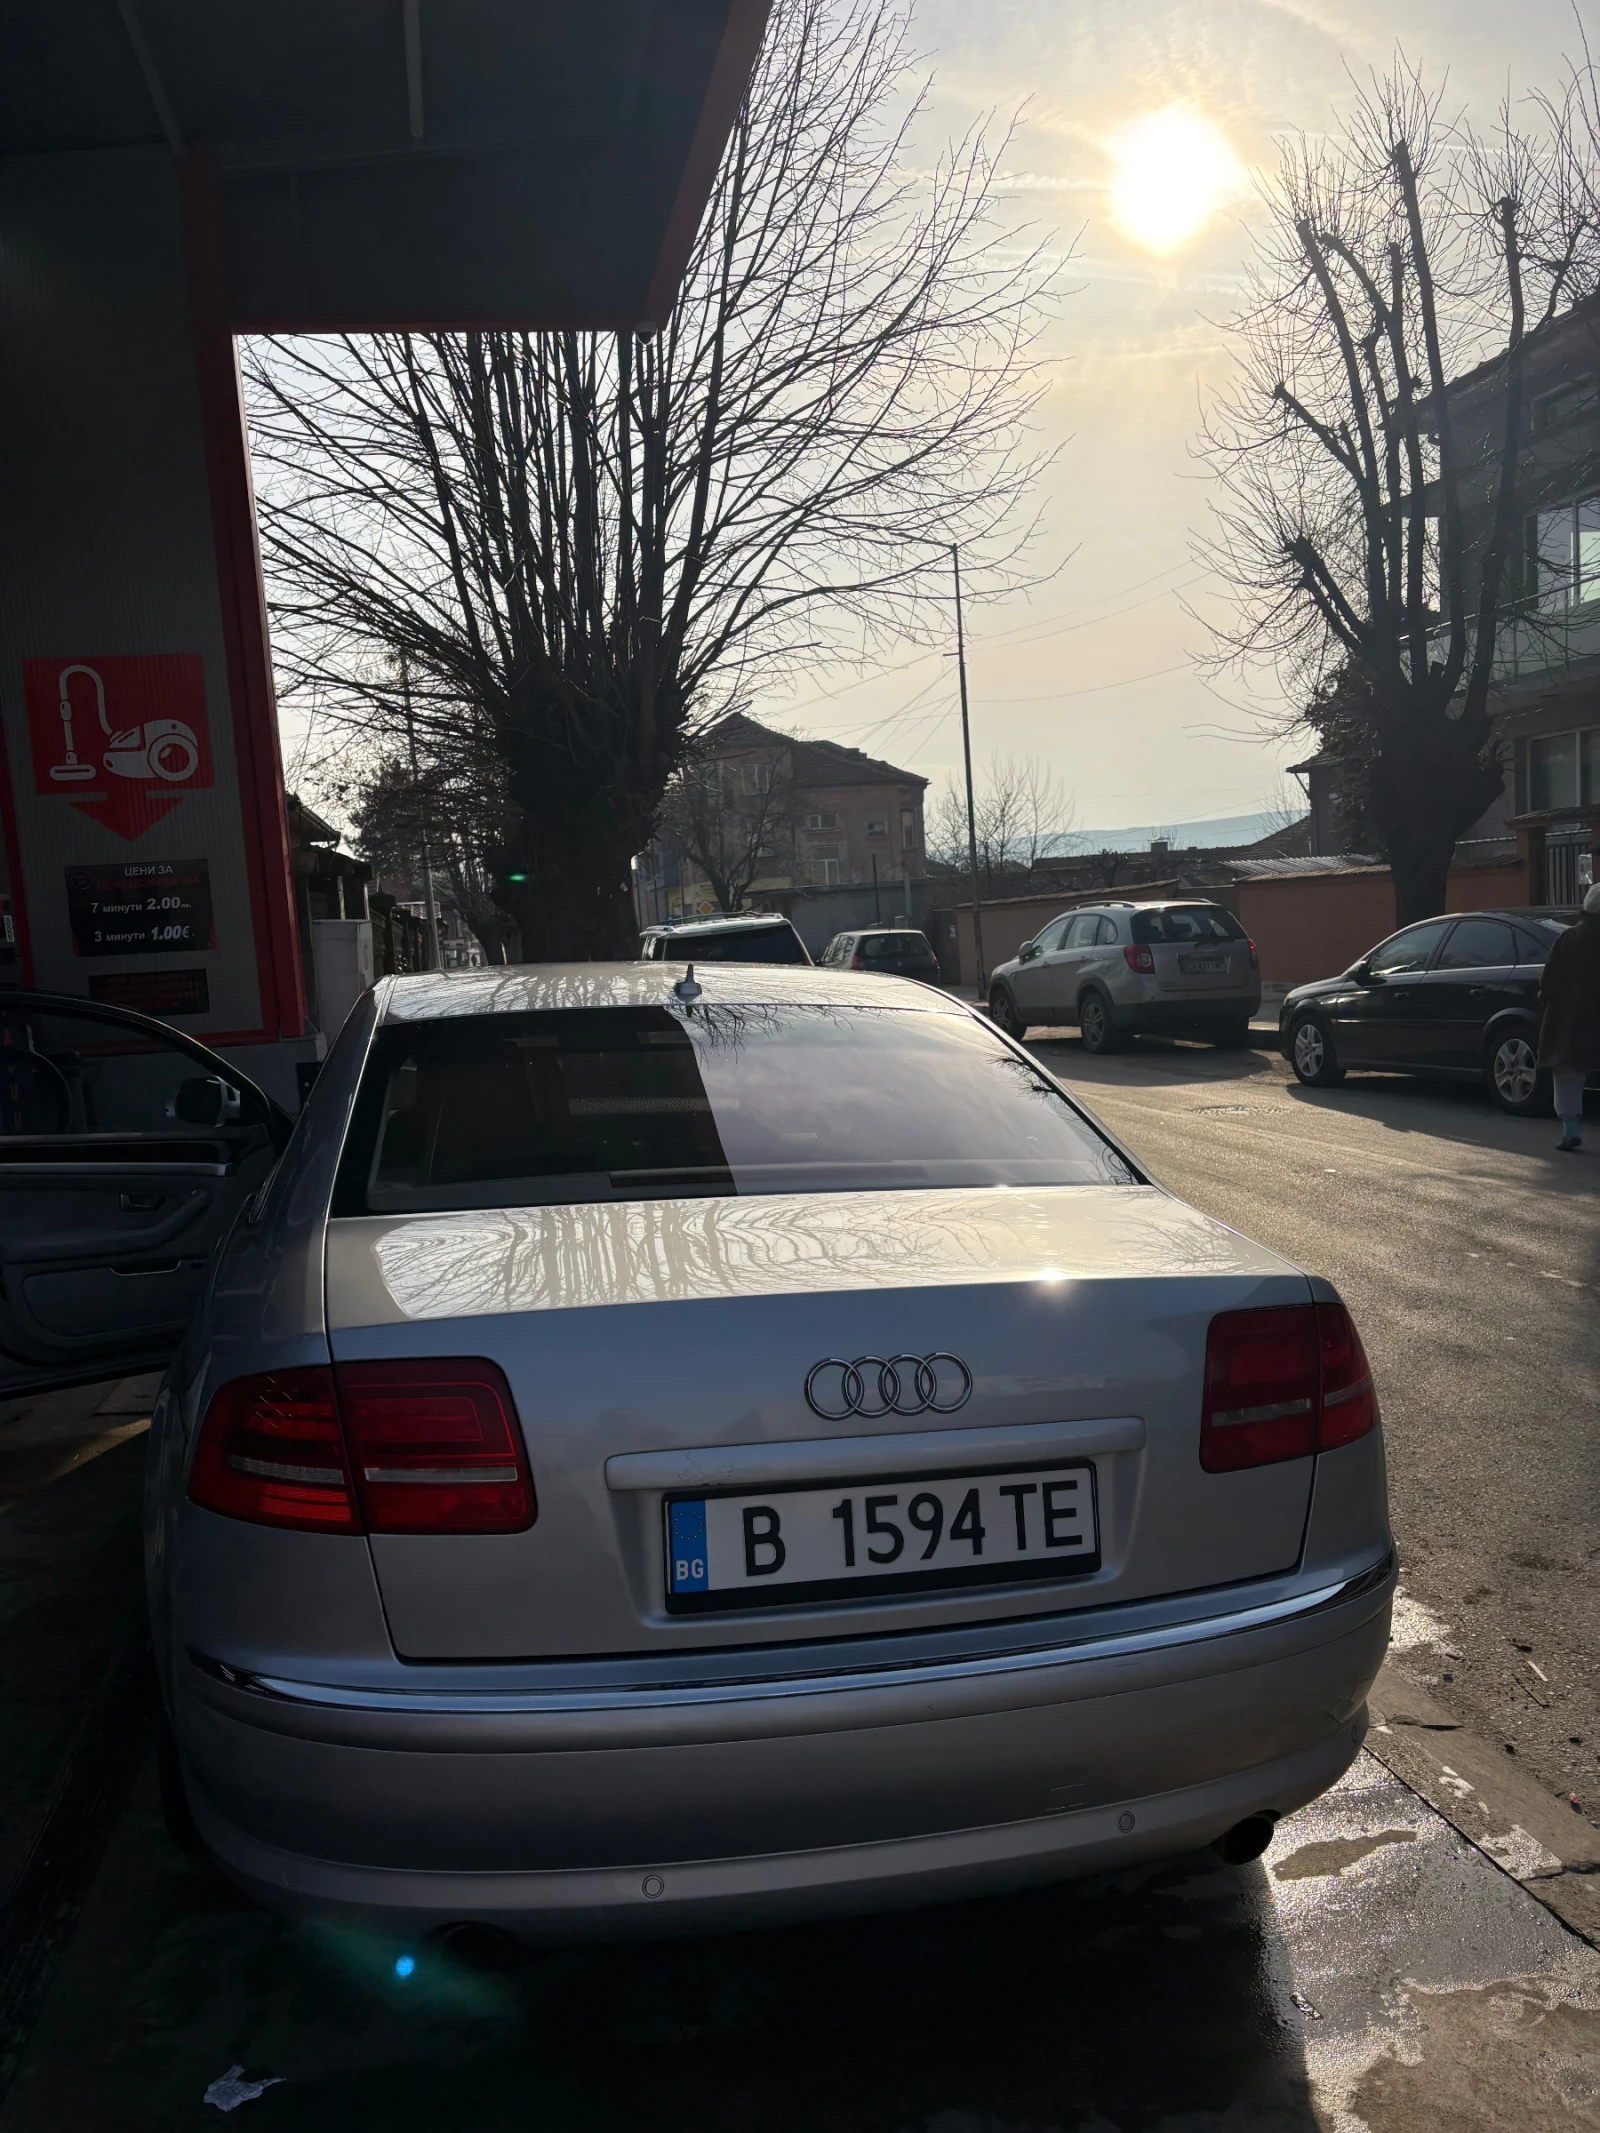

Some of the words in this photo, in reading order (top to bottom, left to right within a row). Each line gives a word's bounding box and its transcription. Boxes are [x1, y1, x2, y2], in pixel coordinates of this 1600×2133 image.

[124, 866, 155, 877] ЦЕНИ
[158, 865, 173, 875] ЗА
[91, 902, 99, 914] 7
[102, 903, 143, 914] минути
[94, 931, 102, 943] 3
[105, 931, 146, 943] минути
[742, 1505, 786, 1577] B
[832, 1488, 986, 1567] 1594
[999, 1480, 1083, 1550] TE
[675, 1558, 705, 1581] BG
